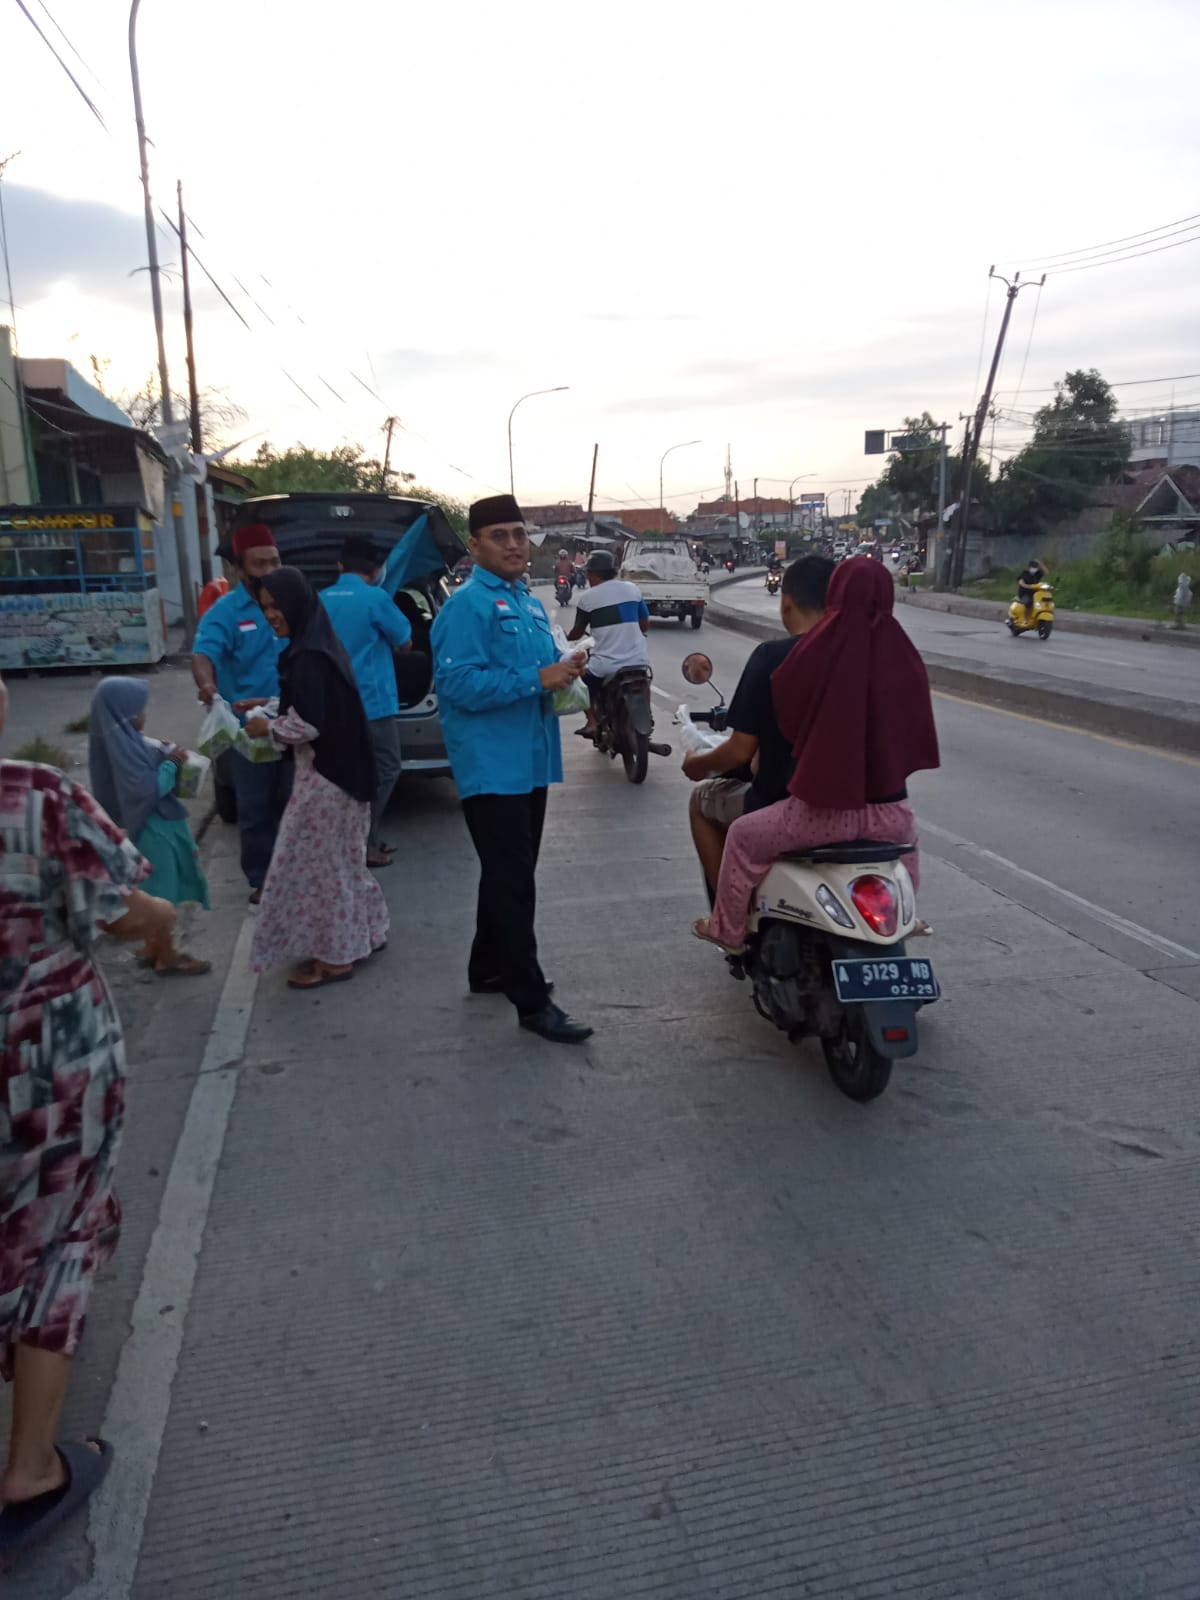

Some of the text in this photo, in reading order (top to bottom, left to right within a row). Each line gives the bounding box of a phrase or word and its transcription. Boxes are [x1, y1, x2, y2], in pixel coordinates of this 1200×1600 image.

[10, 513, 116, 529] CAMPUR
[839, 961, 930, 983] A 5129 NB
